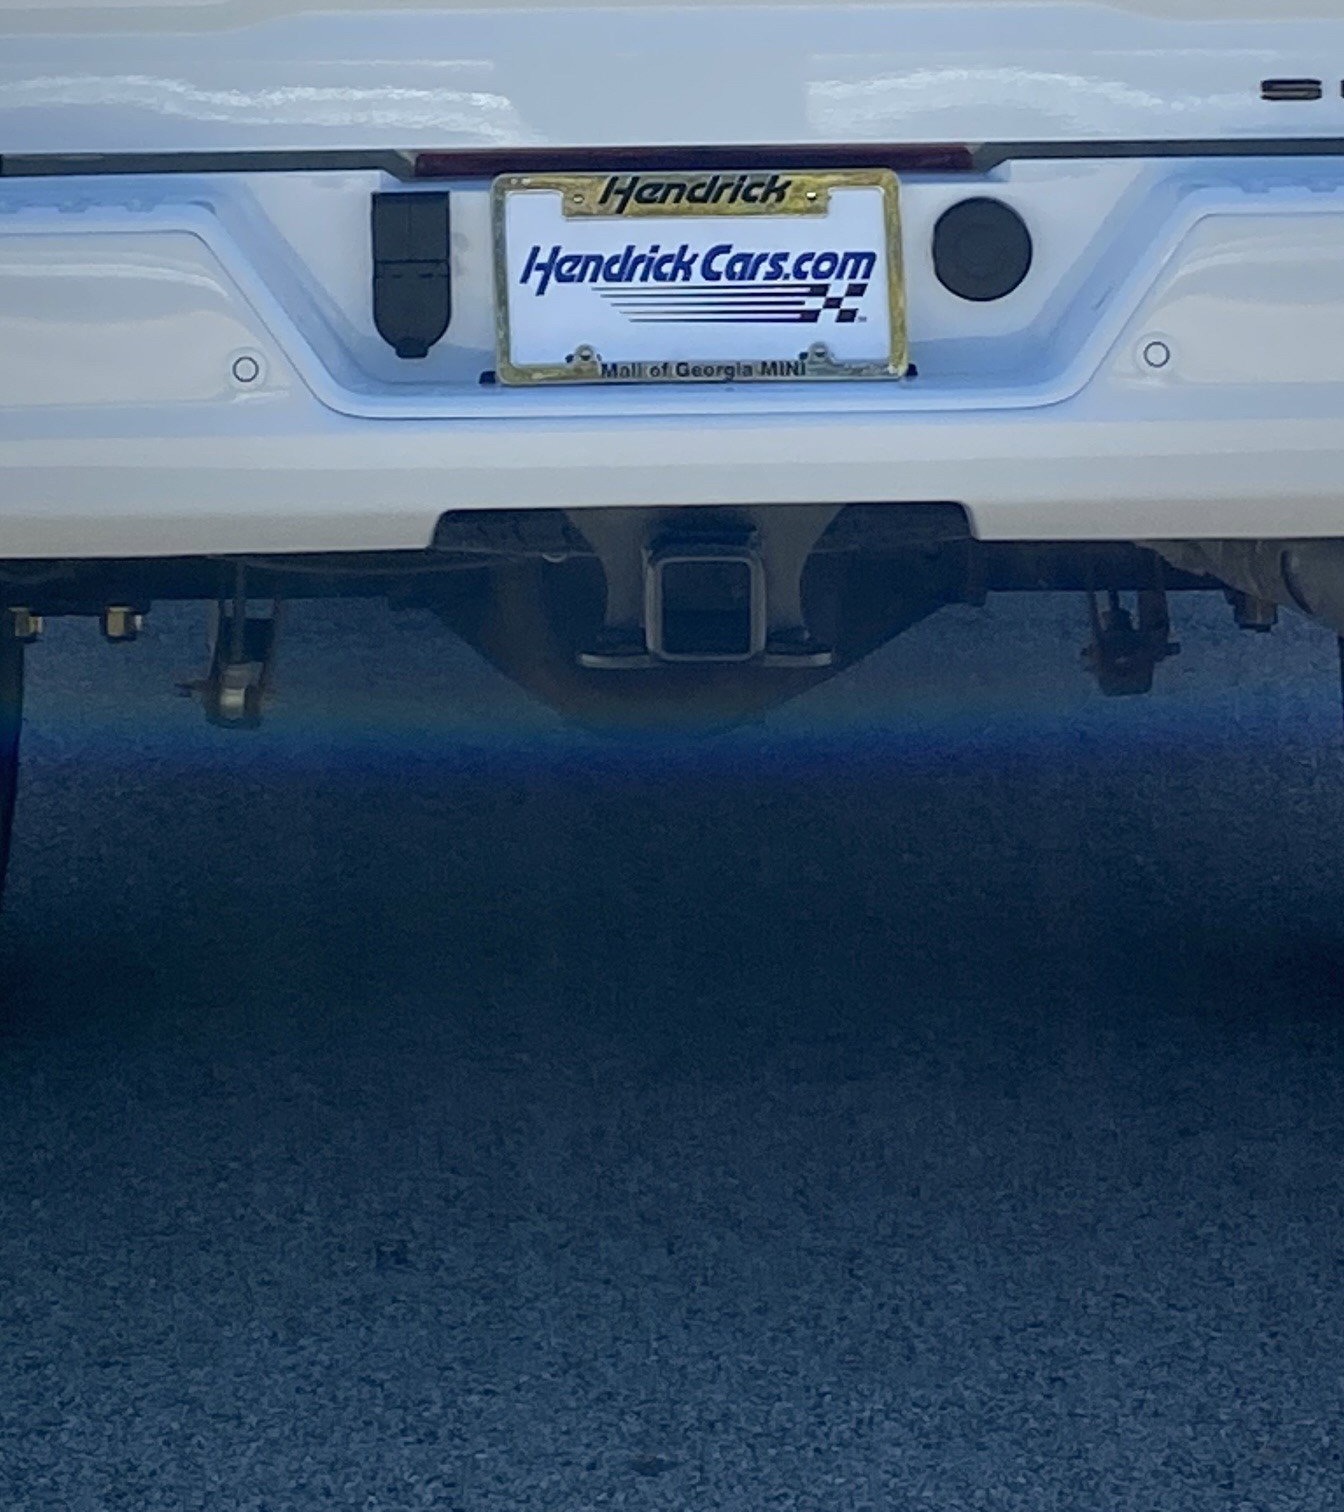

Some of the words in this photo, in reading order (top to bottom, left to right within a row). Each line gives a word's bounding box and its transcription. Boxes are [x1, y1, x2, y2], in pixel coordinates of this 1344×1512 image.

[598, 174, 792, 215] Hendrick
[601, 362, 642, 379] Mall
[649, 361, 669, 378] of
[675, 361, 754, 382] Georgia
[760, 360, 806, 377] MINI
